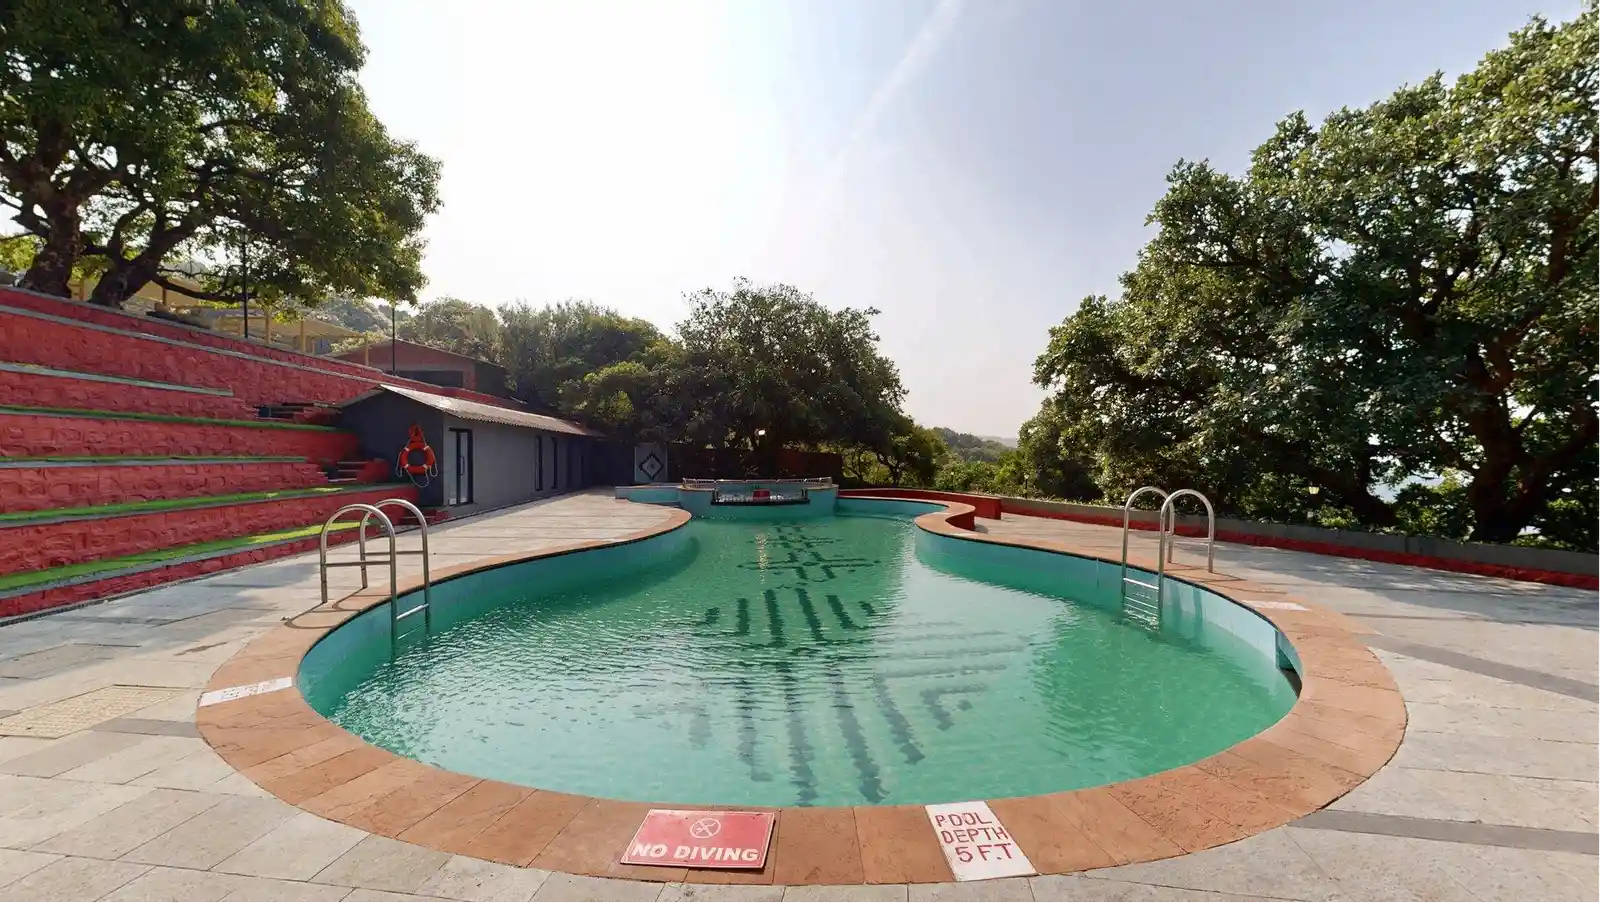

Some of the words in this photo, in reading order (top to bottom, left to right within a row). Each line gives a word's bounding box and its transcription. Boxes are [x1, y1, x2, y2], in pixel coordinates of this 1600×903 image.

[935, 812, 992, 827] POOL
[941, 827, 1008, 844] DEPTH
[631, 843, 667, 857] NO
[673, 845, 759, 861] DIVING
[955, 846, 974, 862] 5
